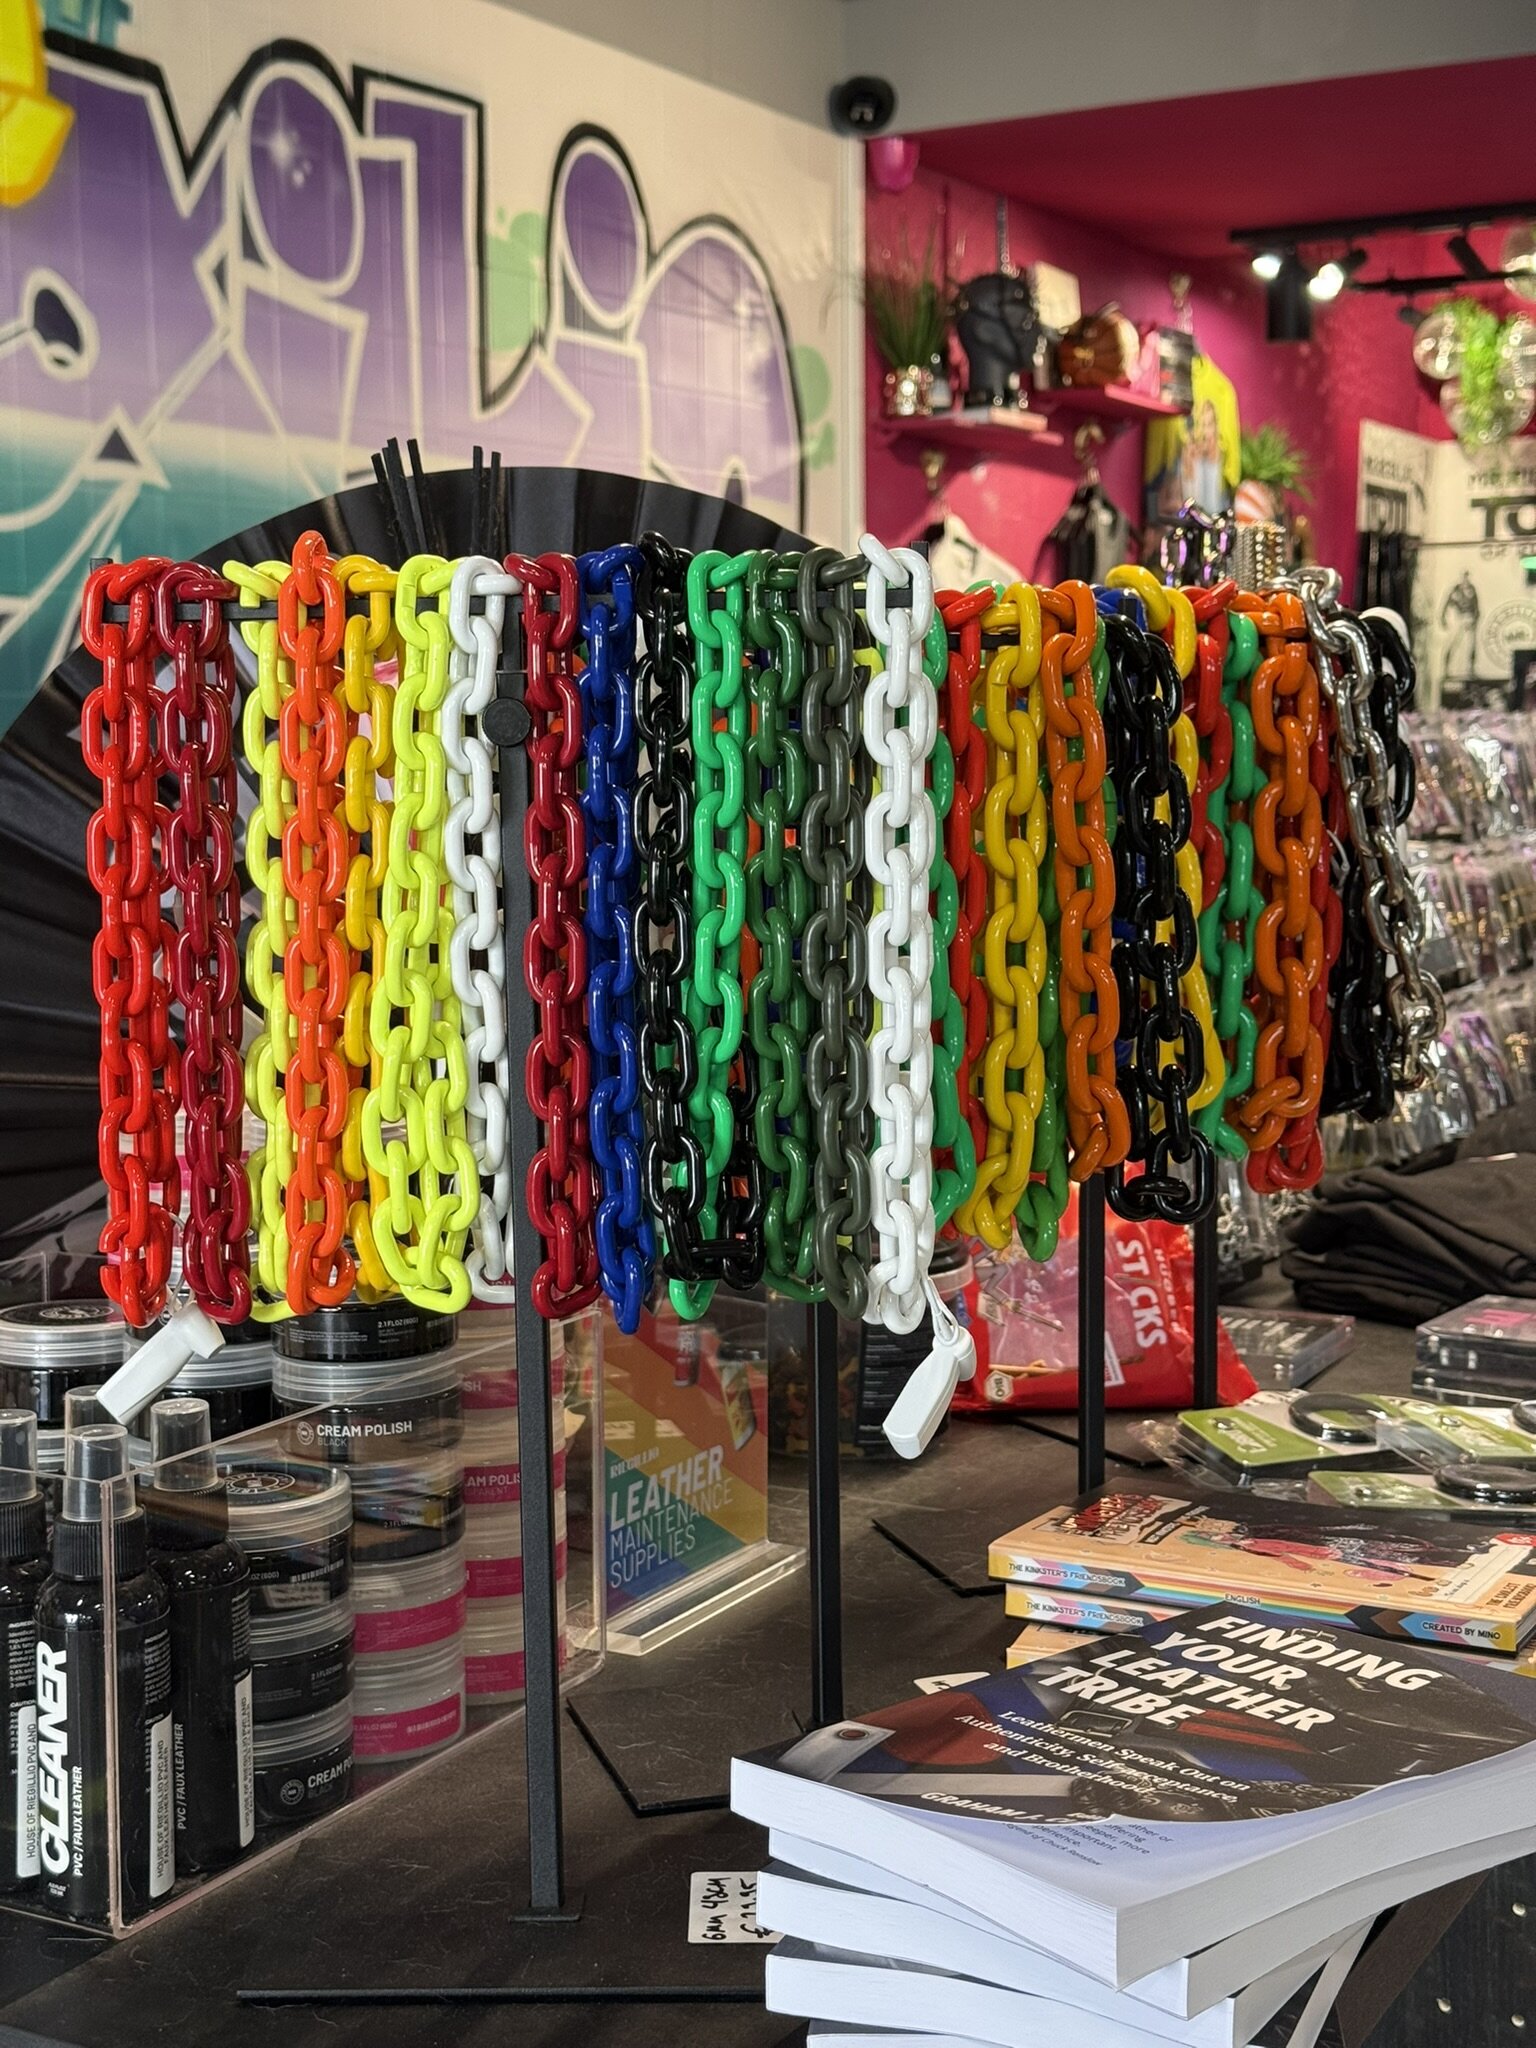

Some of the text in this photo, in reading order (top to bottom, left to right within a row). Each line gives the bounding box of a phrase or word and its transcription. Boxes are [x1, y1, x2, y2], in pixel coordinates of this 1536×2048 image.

[316, 1421, 413, 1437] CREAM POLISH
[317, 1437, 348, 1447] BLACK
[610, 1444, 724, 1532] LEATHER
[611, 1476, 734, 1560] MAINTENANCE
[610, 1524, 696, 1589] SUPPLIES
[1008, 1563, 1024, 1571] THE
[1025, 1565, 1069, 1578] KINKSTER'S
[1026, 1601, 1041, 1610] THE
[1042, 1604, 1086, 1617] KINKSTER'S
[1225, 1593, 1261, 1605] ENGLISH
[1422, 1622, 1501, 1640] CREATED BY MINO
[1150, 1631, 1308, 1687] YOUR
[1196, 1615, 1445, 1691] FINDING
[1038, 1666, 1206, 1727] TRIBE
[1089, 1649, 1336, 1732] LEATHER
[27, 1723, 36, 1743] AND
[174, 1723, 185, 1770] LEATHER
[954, 1714, 1072, 1759] Authenticity,
[27, 1745, 36, 1764] PVC
[36, 1641, 70, 1874] CLEANER
[998, 1710, 1251, 1791] Leathermen Speak Out on
[308, 1762, 343, 1788] CREAM
[984, 1741, 1156, 1795] and Brotherhood
[72, 1765, 83, 1815] LEATHER
[176, 1771, 186, 1800] FAUX
[27, 1813, 36, 1825] OF
[177, 1807, 187, 1830] PVC
[920, 1791, 1027, 1818] GRAHAM
[27, 1826, 36, 1858] HOUSE
[72, 1815, 83, 1846] FAUX
[1063, 1826, 1118, 1851] important
[1120, 1840, 1150, 1855] more
[73, 1852, 83, 1877] PVC
